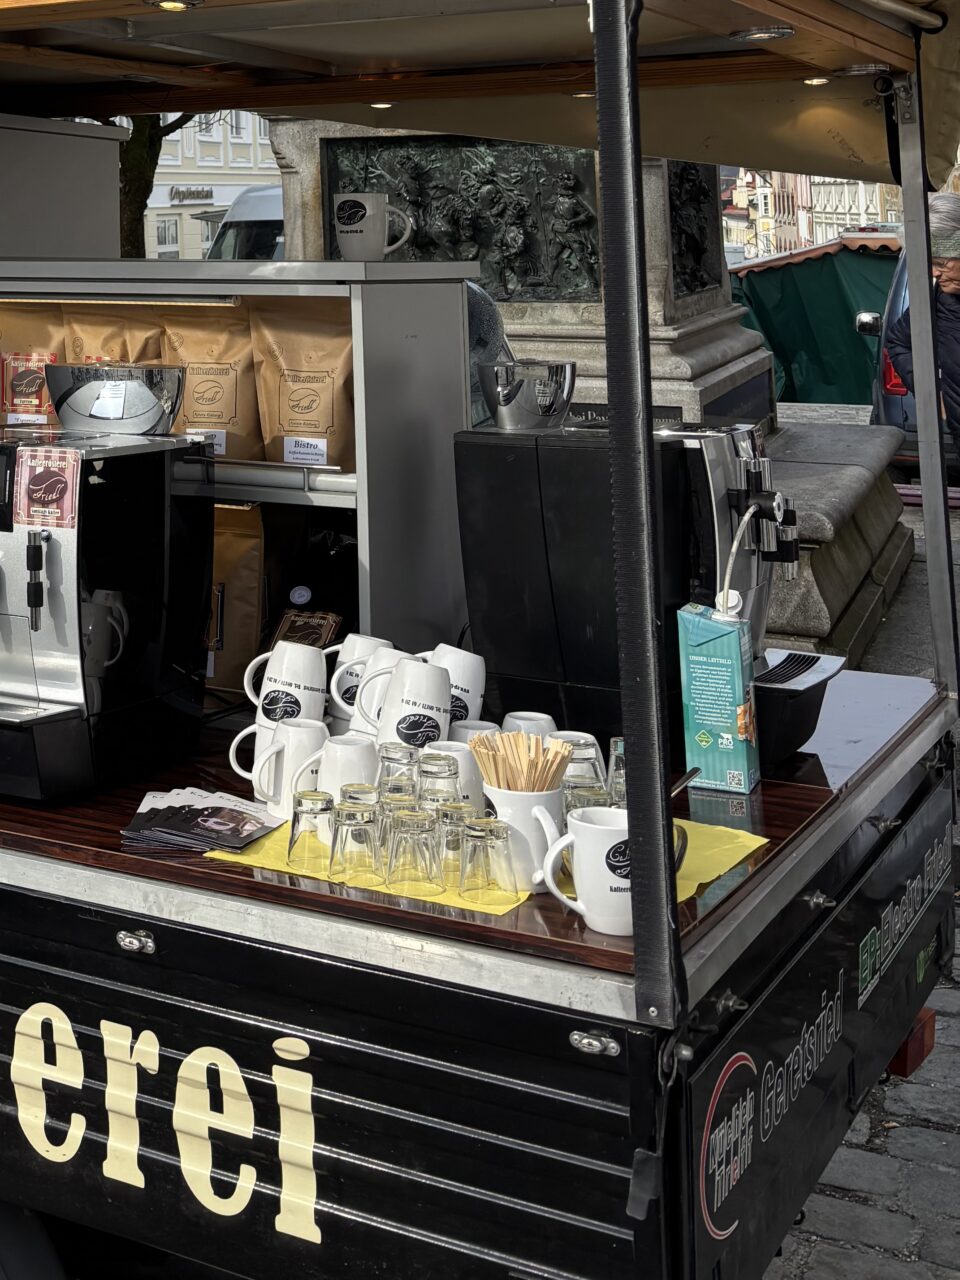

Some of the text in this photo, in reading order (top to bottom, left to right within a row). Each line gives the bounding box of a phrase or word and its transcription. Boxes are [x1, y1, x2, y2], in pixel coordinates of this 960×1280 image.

[293, 439, 318, 450] Bistro
[27, 459, 68, 469] Kaffeerösterei
[32, 483, 65, 501] Friedl
[759, 968, 844, 1143] Geretsried
